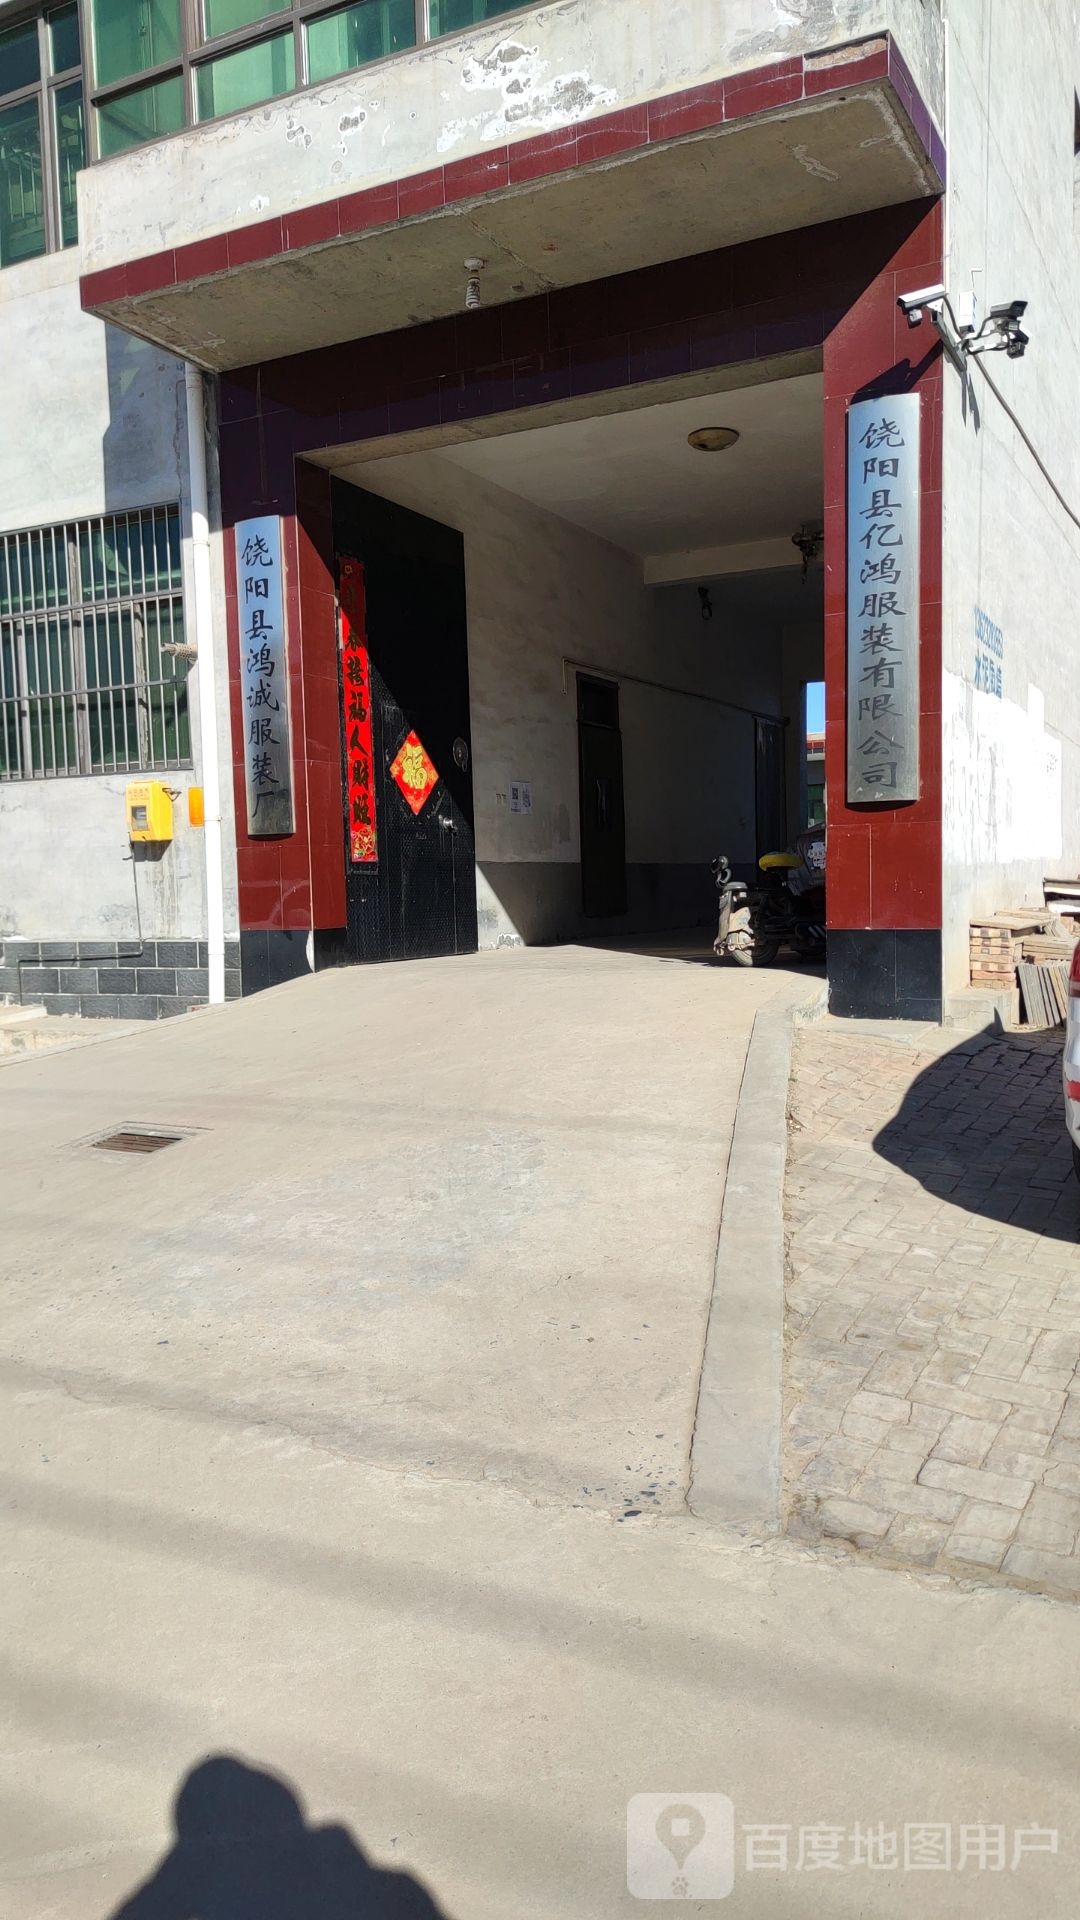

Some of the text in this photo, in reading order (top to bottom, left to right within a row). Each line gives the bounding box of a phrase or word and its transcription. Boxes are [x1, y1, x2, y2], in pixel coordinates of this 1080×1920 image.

[241, 535, 280, 819] 饶阳县鸿诚服装厂
[857, 417, 906, 789] 饶阳县亿鸿服装有限公司
[401, 742, 428, 790] 福
